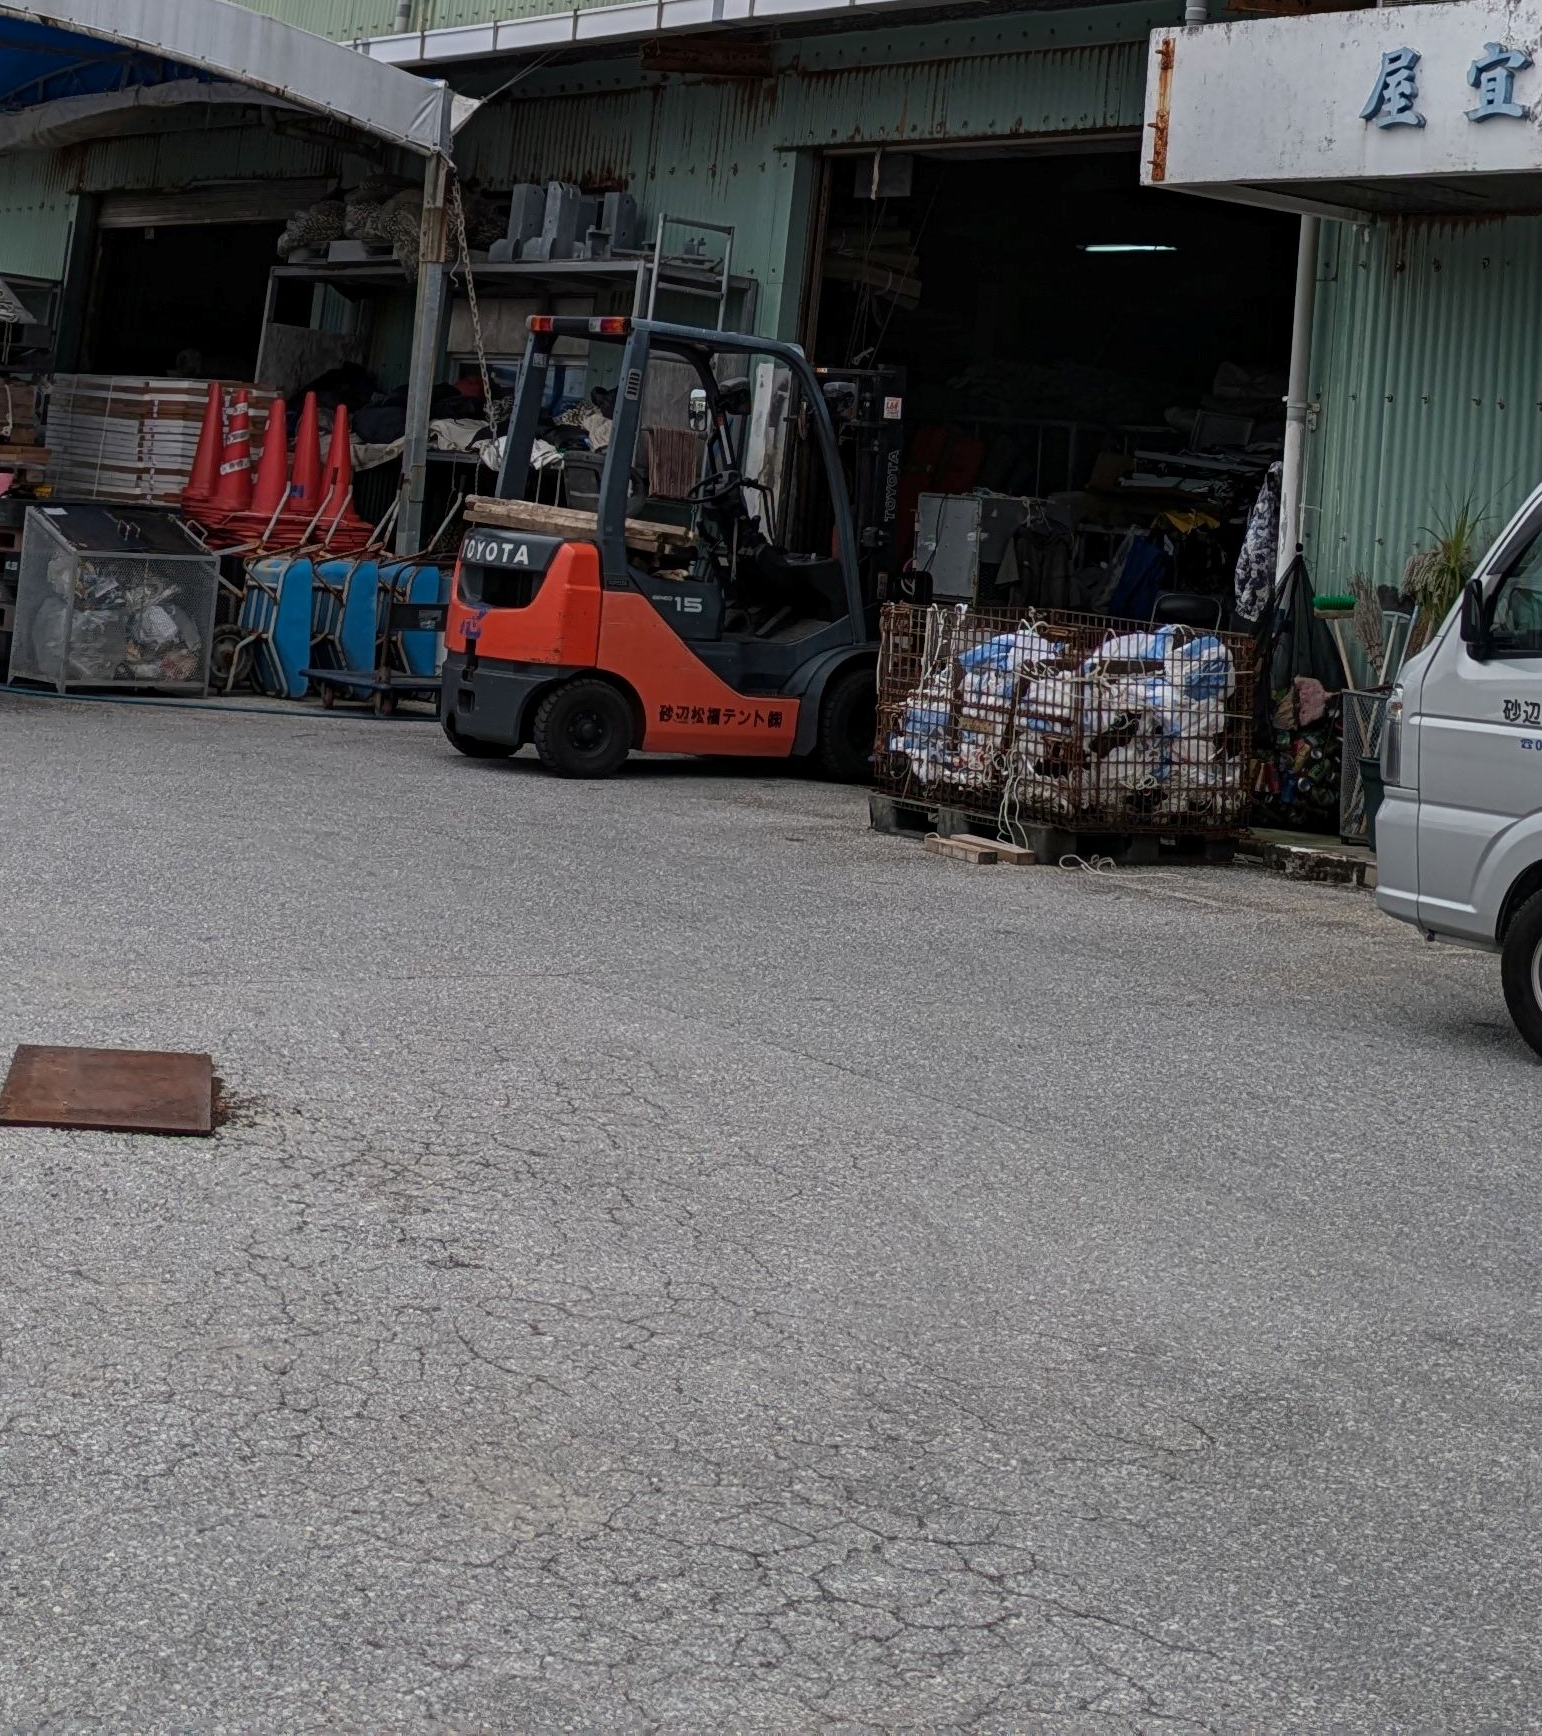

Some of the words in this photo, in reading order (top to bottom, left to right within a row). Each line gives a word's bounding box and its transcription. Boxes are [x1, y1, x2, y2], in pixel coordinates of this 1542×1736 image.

[884, 449, 900, 522] TOYOTA
[462, 539, 529, 566] TOYOTA
[674, 596, 703, 613] 15
